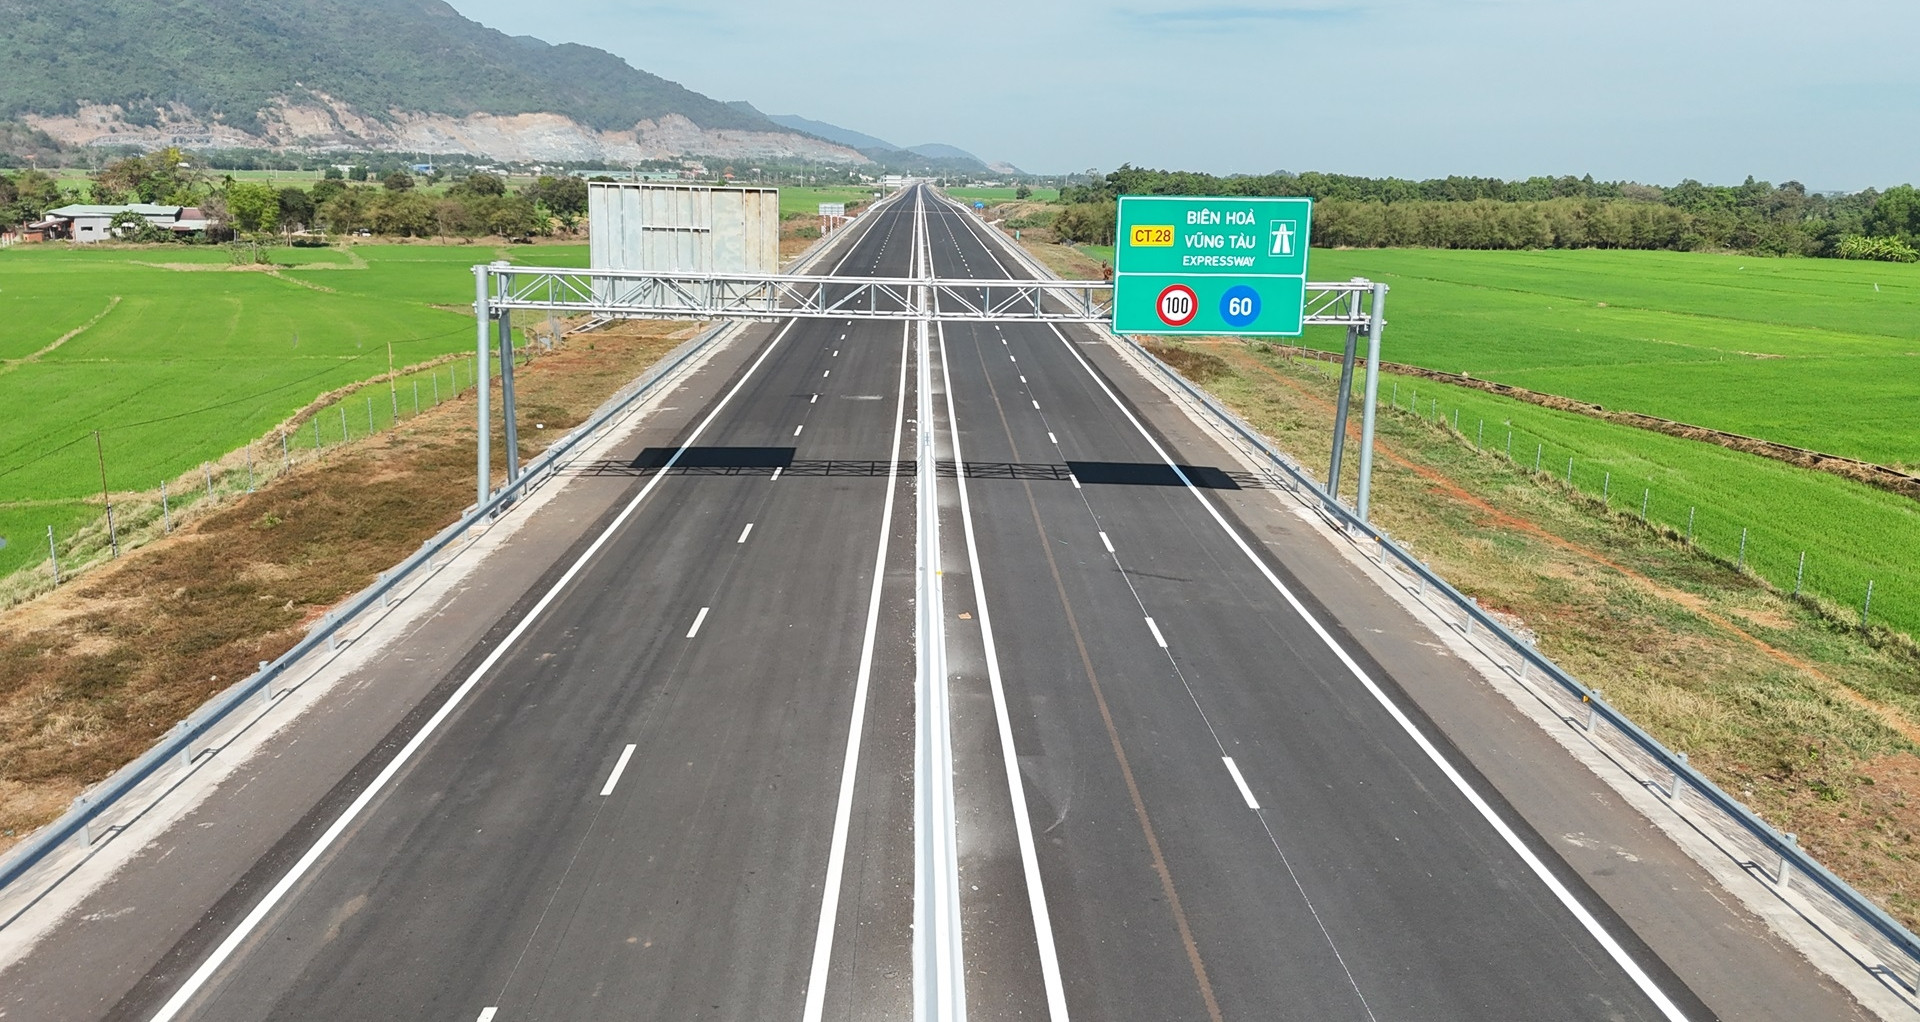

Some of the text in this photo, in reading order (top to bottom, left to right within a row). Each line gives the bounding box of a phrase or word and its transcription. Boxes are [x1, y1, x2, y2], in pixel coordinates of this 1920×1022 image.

[1187, 208, 1256, 225] BIÊN HOÀ
[1135, 229, 1171, 242] CT.28
[1184, 232, 1256, 249] VŨNG TÀU
[1182, 255, 1255, 266] EXPRESSWAY
[1165, 297, 1189, 314] 100
[1229, 297, 1252, 316] 60
